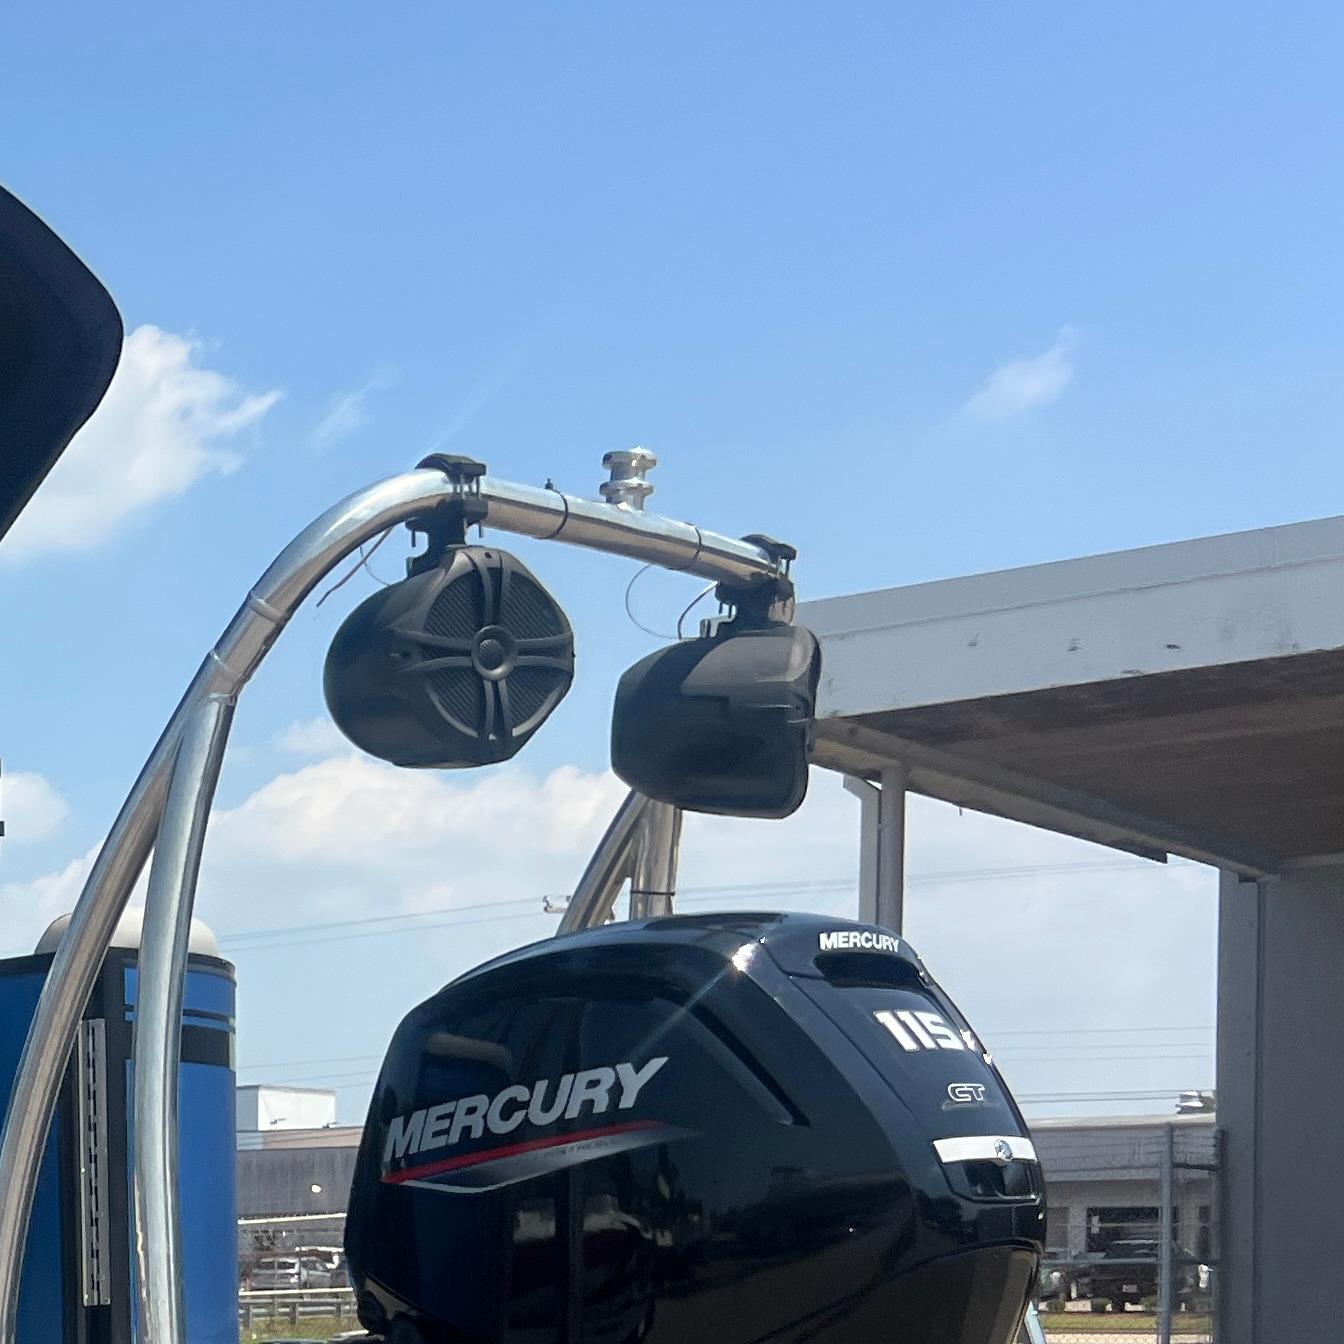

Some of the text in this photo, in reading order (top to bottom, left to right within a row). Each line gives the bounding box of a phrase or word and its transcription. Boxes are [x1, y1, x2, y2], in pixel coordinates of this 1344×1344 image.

[819, 931, 900, 952] MERCURY
[873, 1010, 965, 1052] 115
[384, 1056, 669, 1162] MERCURY
